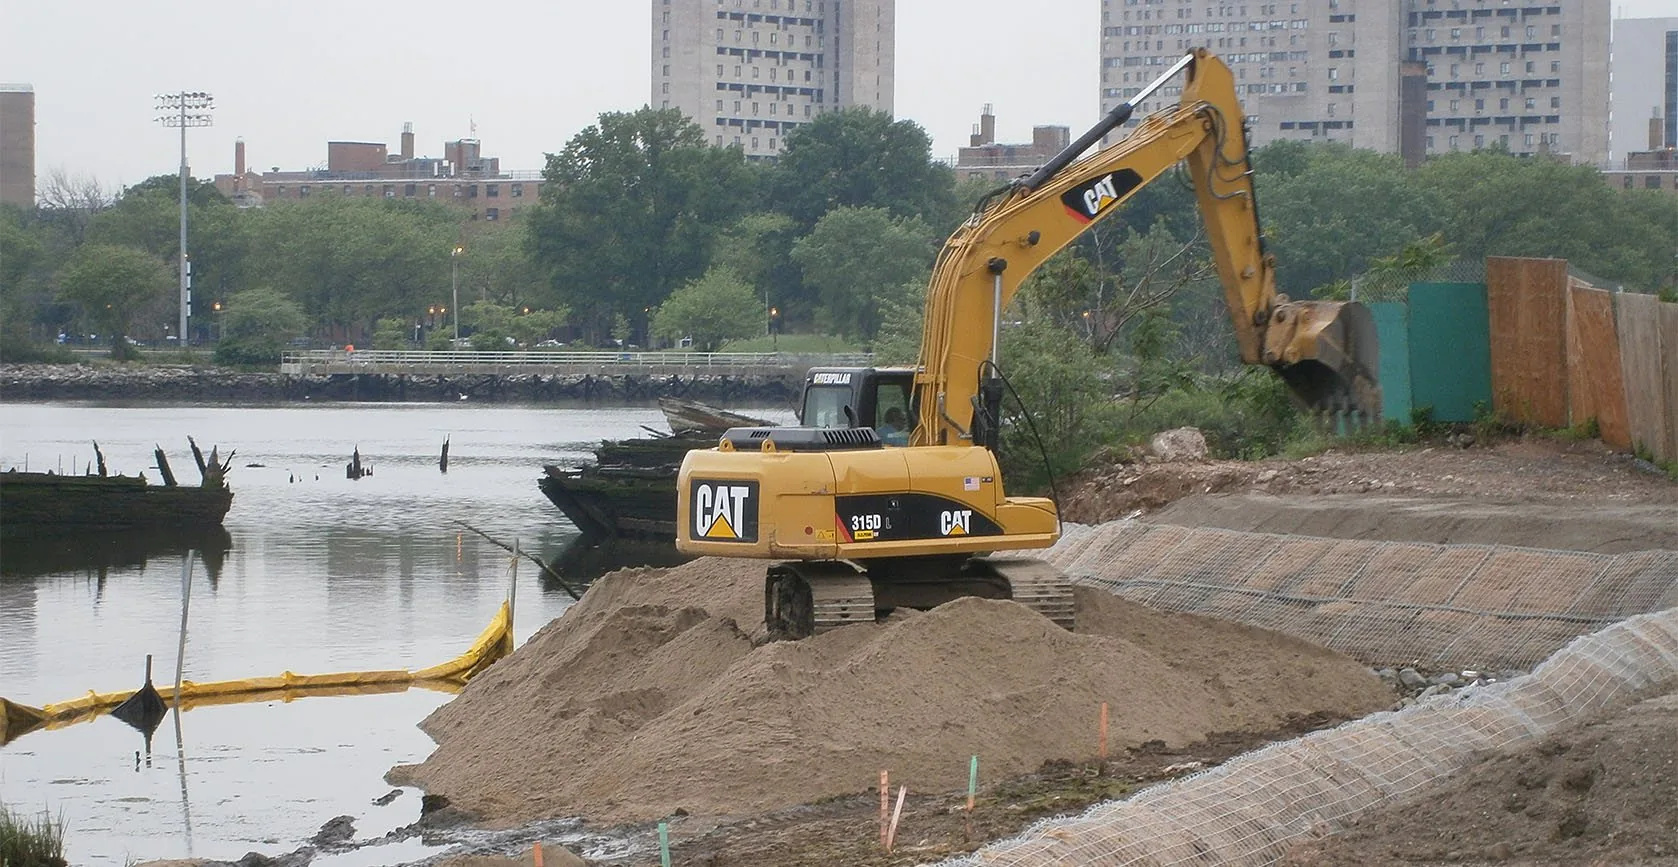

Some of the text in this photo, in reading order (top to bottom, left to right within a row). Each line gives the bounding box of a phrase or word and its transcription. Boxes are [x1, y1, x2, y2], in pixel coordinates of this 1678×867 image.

[1083, 173, 1118, 215] CAT
[813, 373, 852, 385] CATERPILLAR
[696, 484, 749, 538] CAT
[851, 514, 882, 531] 315D
[941, 510, 972, 536] CAT
